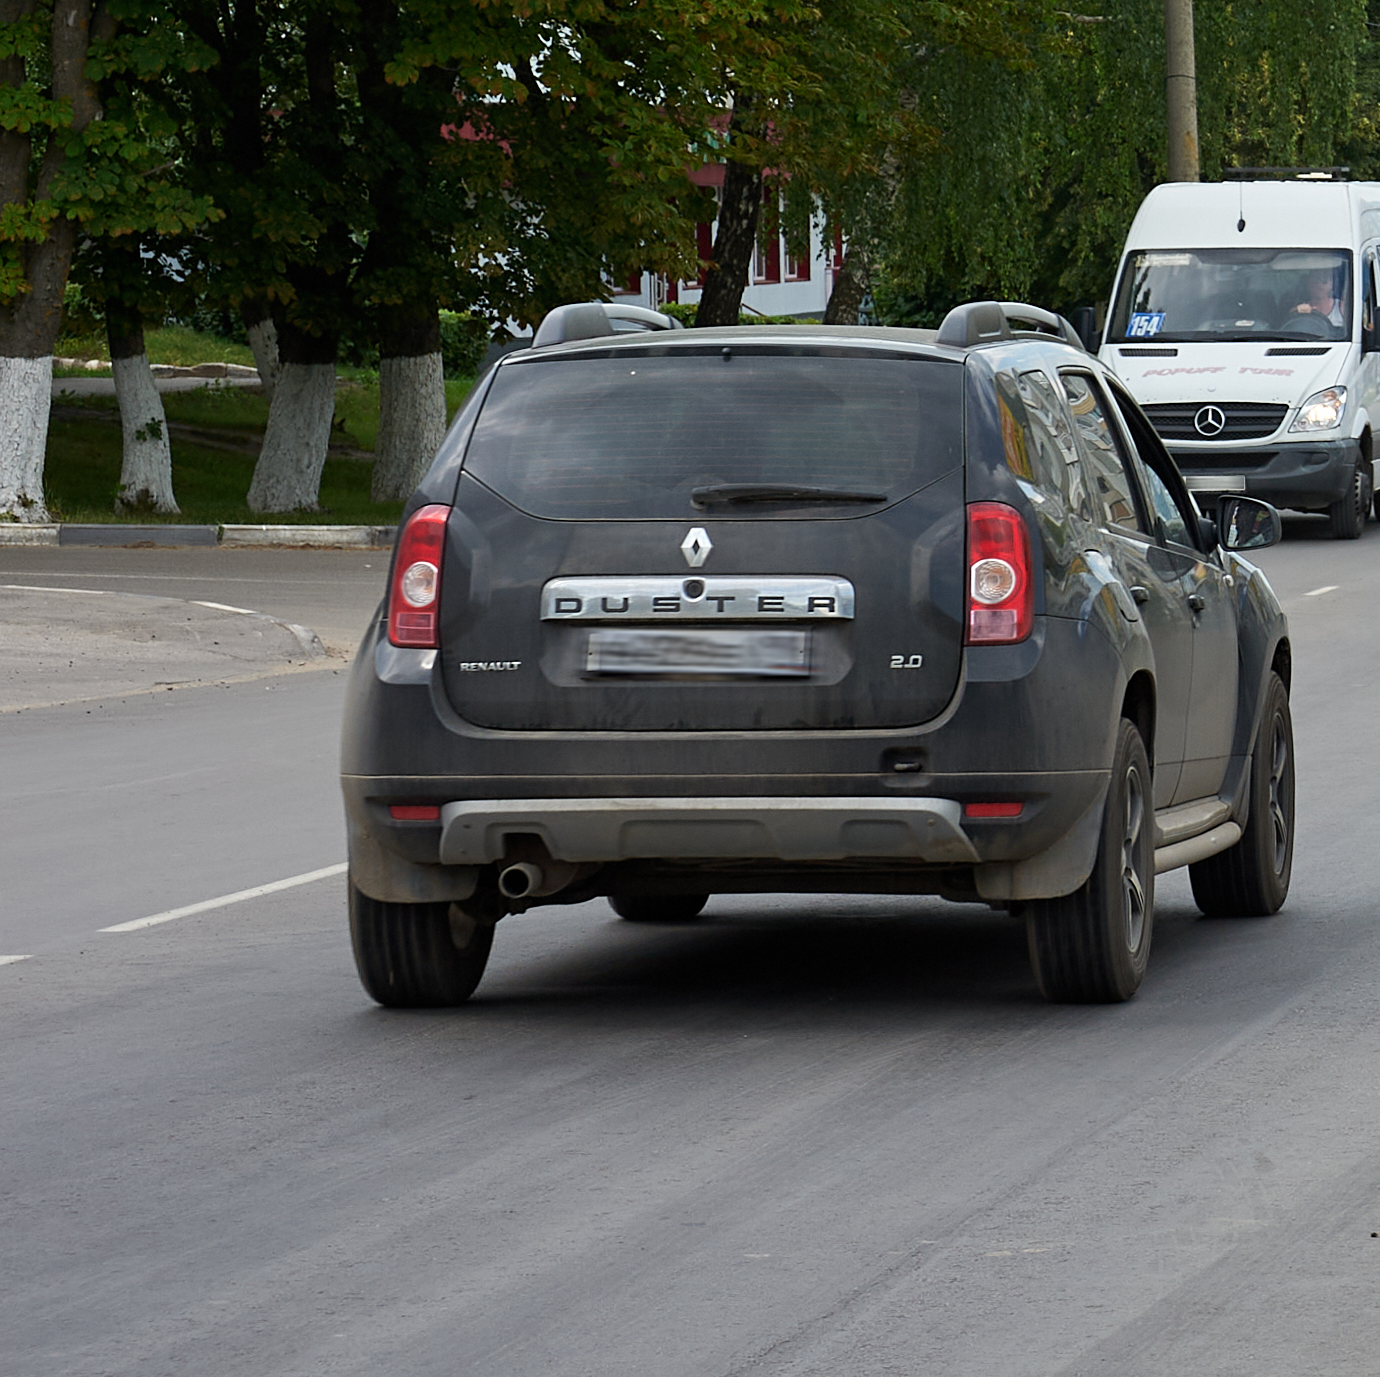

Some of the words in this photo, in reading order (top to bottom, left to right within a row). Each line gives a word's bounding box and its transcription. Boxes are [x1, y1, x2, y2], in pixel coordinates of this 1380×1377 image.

[1130, 315, 1161, 337] 154
[1238, 366, 1295, 377] TOUR
[554, 596, 836, 615] DUSTER
[459, 659, 522, 673] RENAULT
[890, 654, 923, 670] 2.0
